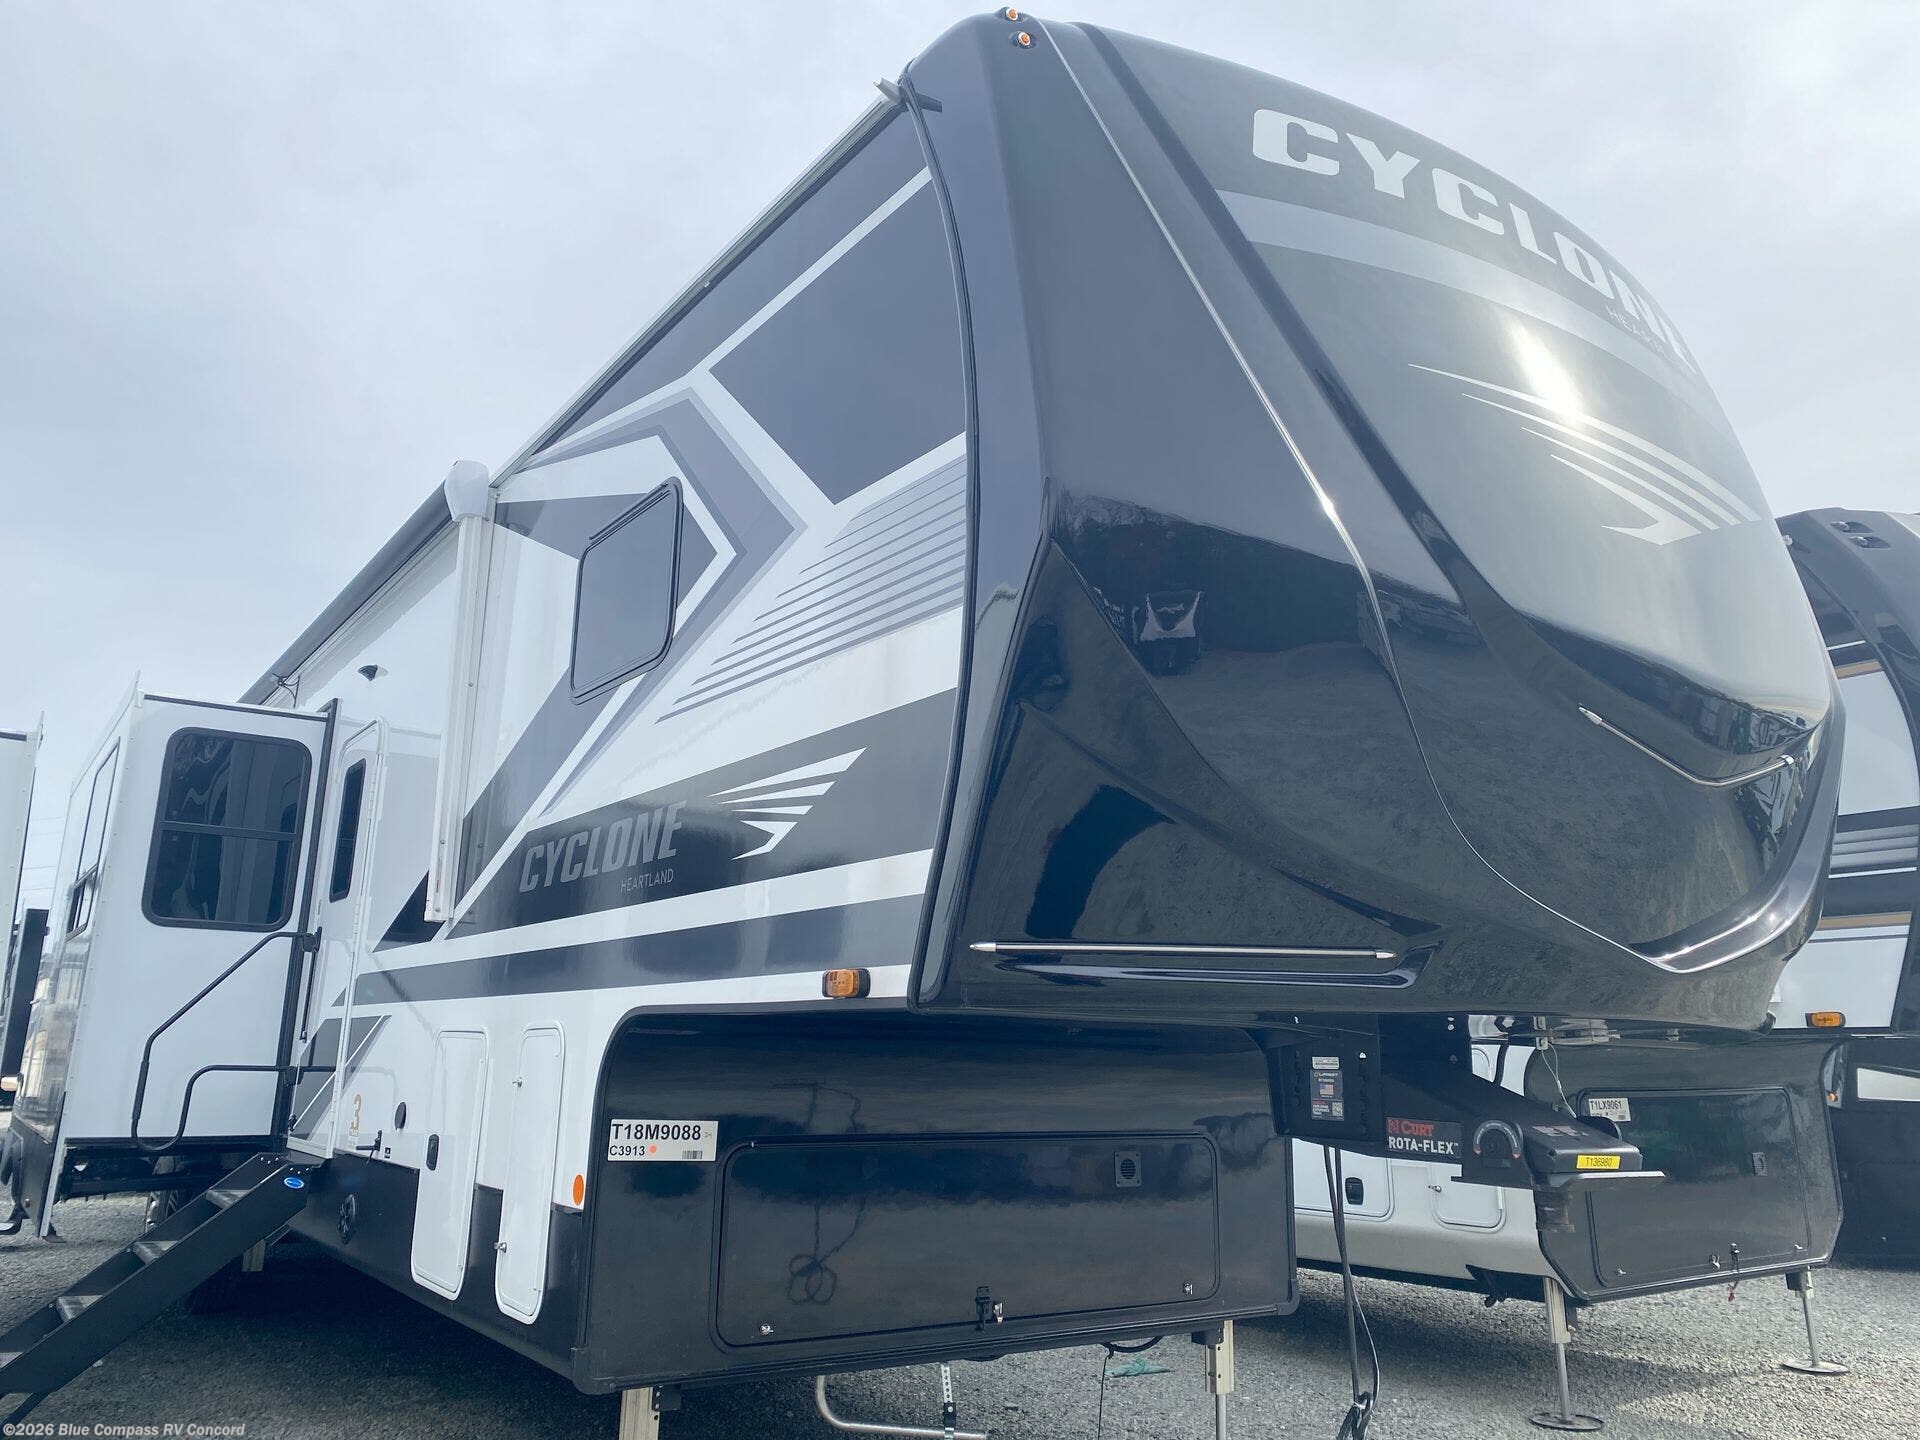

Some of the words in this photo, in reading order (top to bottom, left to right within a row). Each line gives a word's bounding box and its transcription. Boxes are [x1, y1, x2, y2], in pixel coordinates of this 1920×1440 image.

[519, 801, 686, 892] CYCLONE
[620, 868, 674, 893] HEARTLAND
[611, 1123, 701, 1141] T18M9088
[1401, 1120, 1434, 1137] CURT
[609, 1145, 646, 1156] C3913
